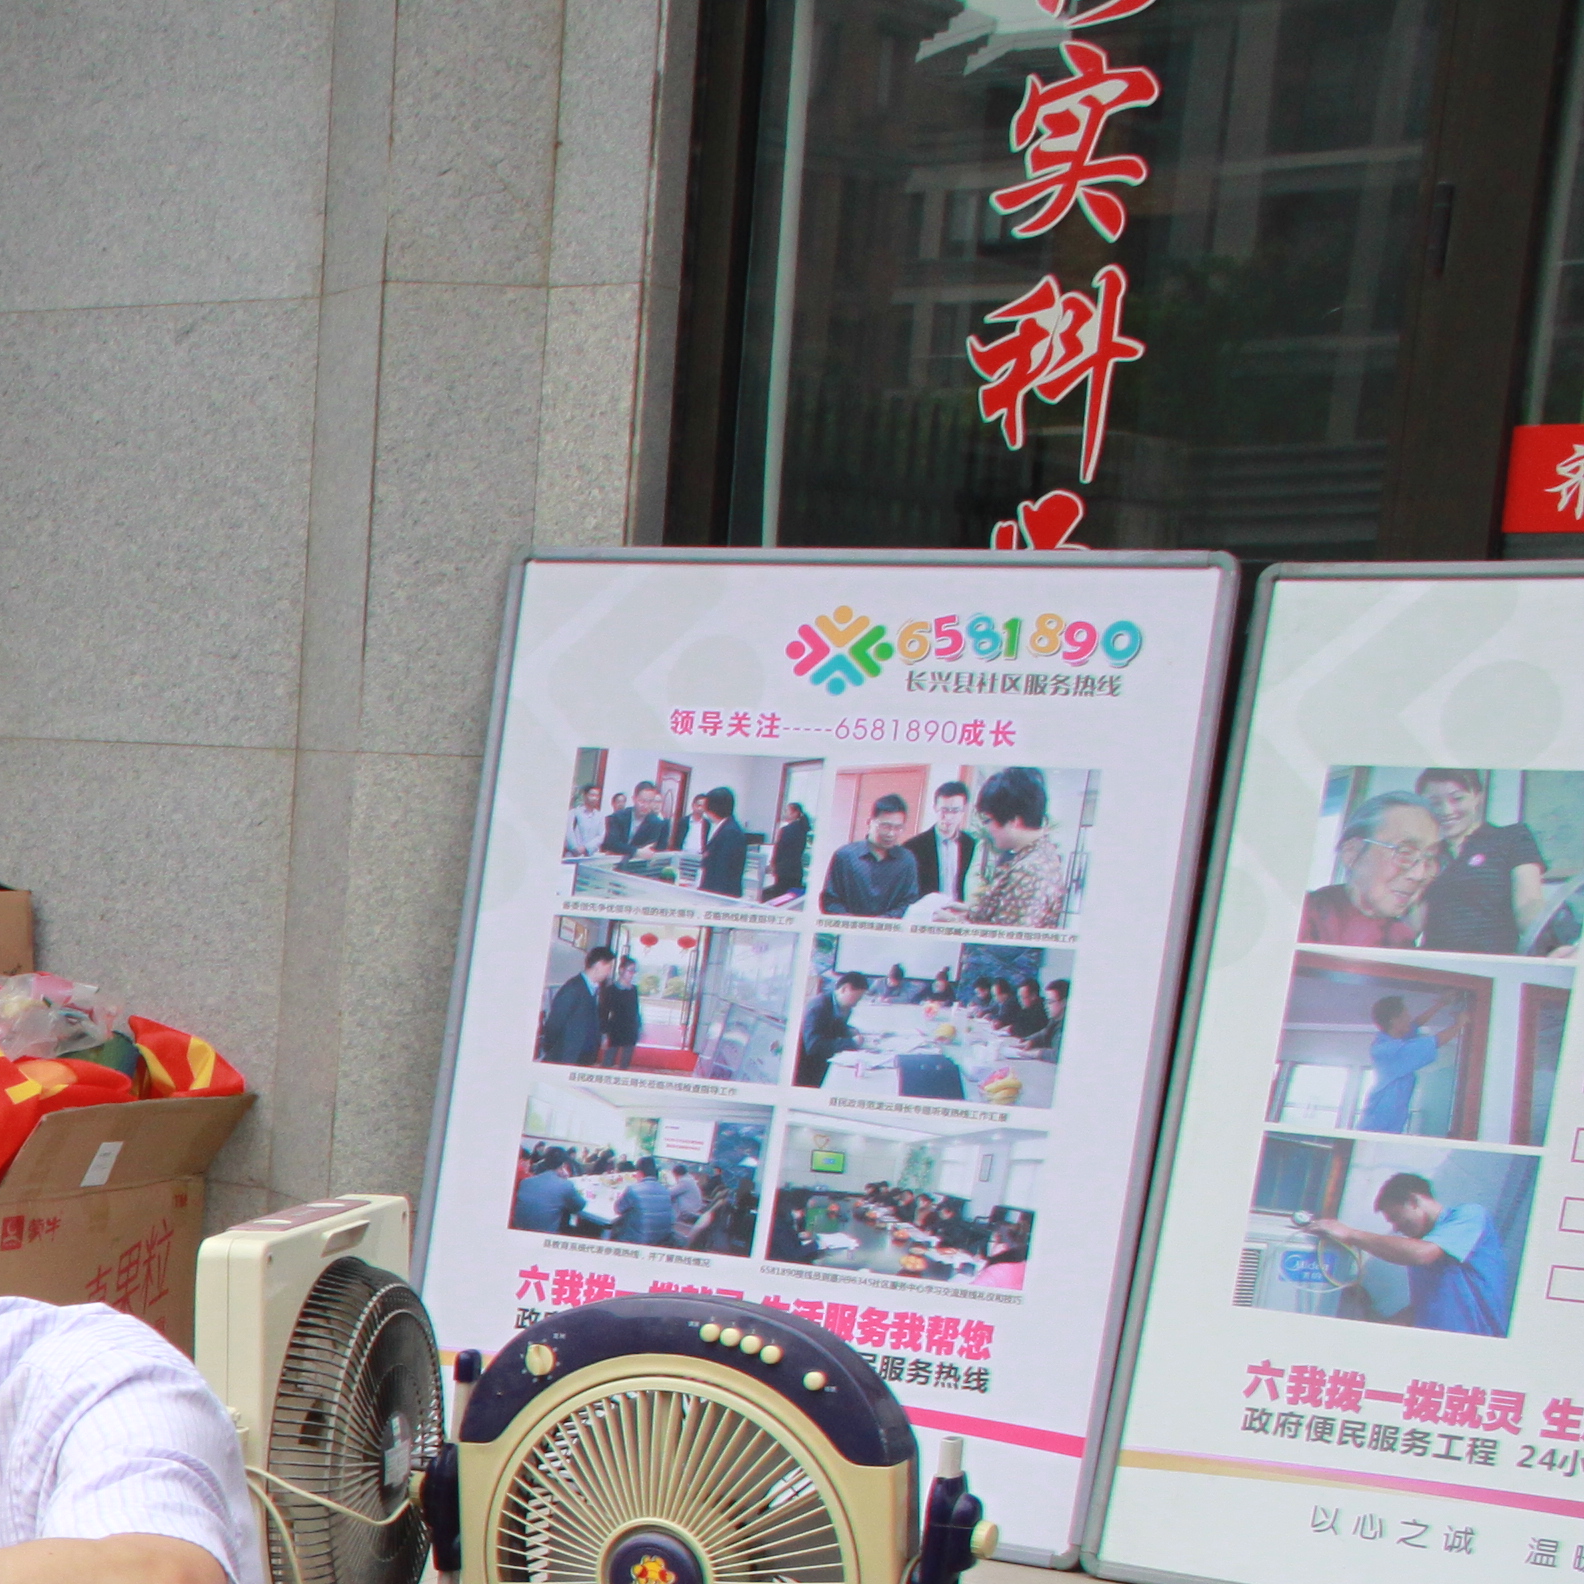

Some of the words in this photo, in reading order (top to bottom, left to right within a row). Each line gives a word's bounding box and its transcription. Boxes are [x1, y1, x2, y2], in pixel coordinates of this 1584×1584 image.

[895, 613, 1142, 668] 6581890
[905, 670, 1122, 697] 长兴县社区服务热线
[29, 1215, 62, 1243] 蒙牛
[1243, 1360, 1527, 1437] 六我拨一拨就灵
[1241, 1408, 1497, 1467] 政府便民服务工程
[1311, 1505, 1475, 1556] 以心之诚
